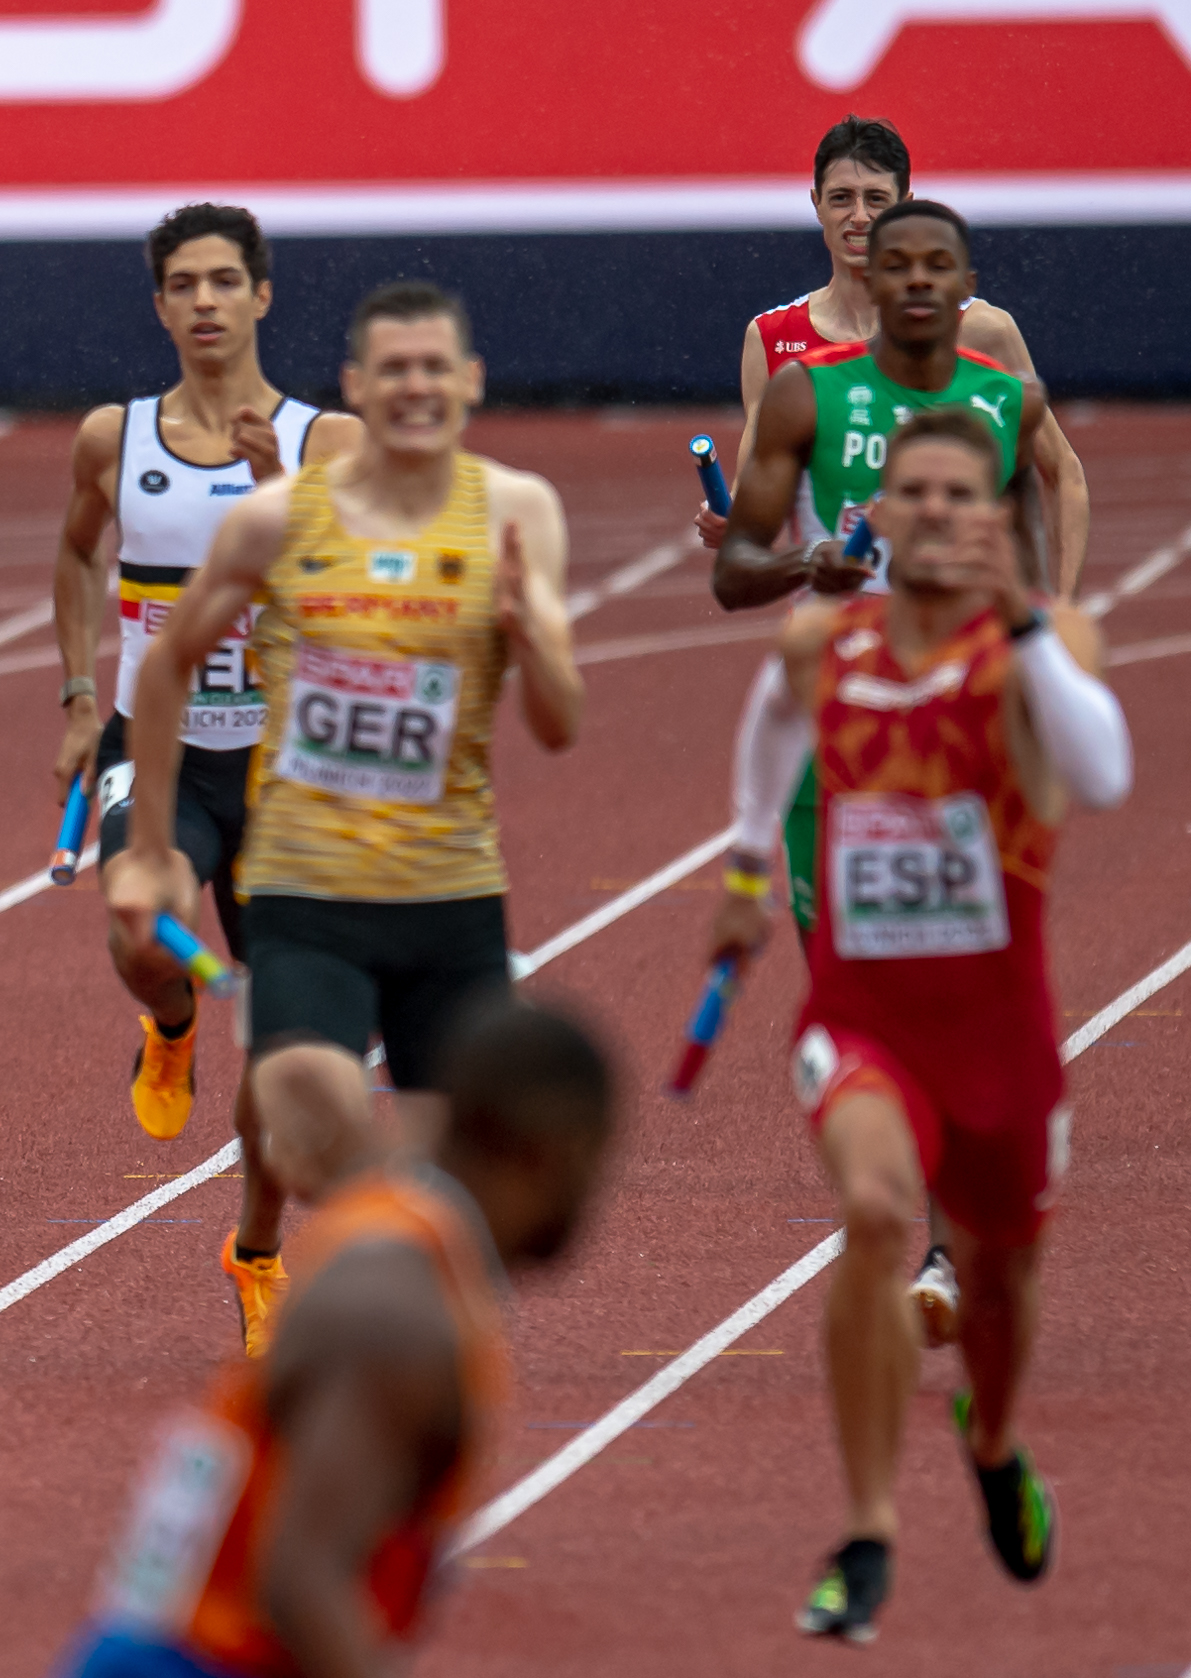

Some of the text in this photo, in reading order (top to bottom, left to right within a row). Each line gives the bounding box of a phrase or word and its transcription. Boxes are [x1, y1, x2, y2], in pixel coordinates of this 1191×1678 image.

[785, 341, 807, 353] UBS
[233, 709, 268, 728] 202
[296, 692, 437, 763] GER
[848, 850, 978, 907] ESP
